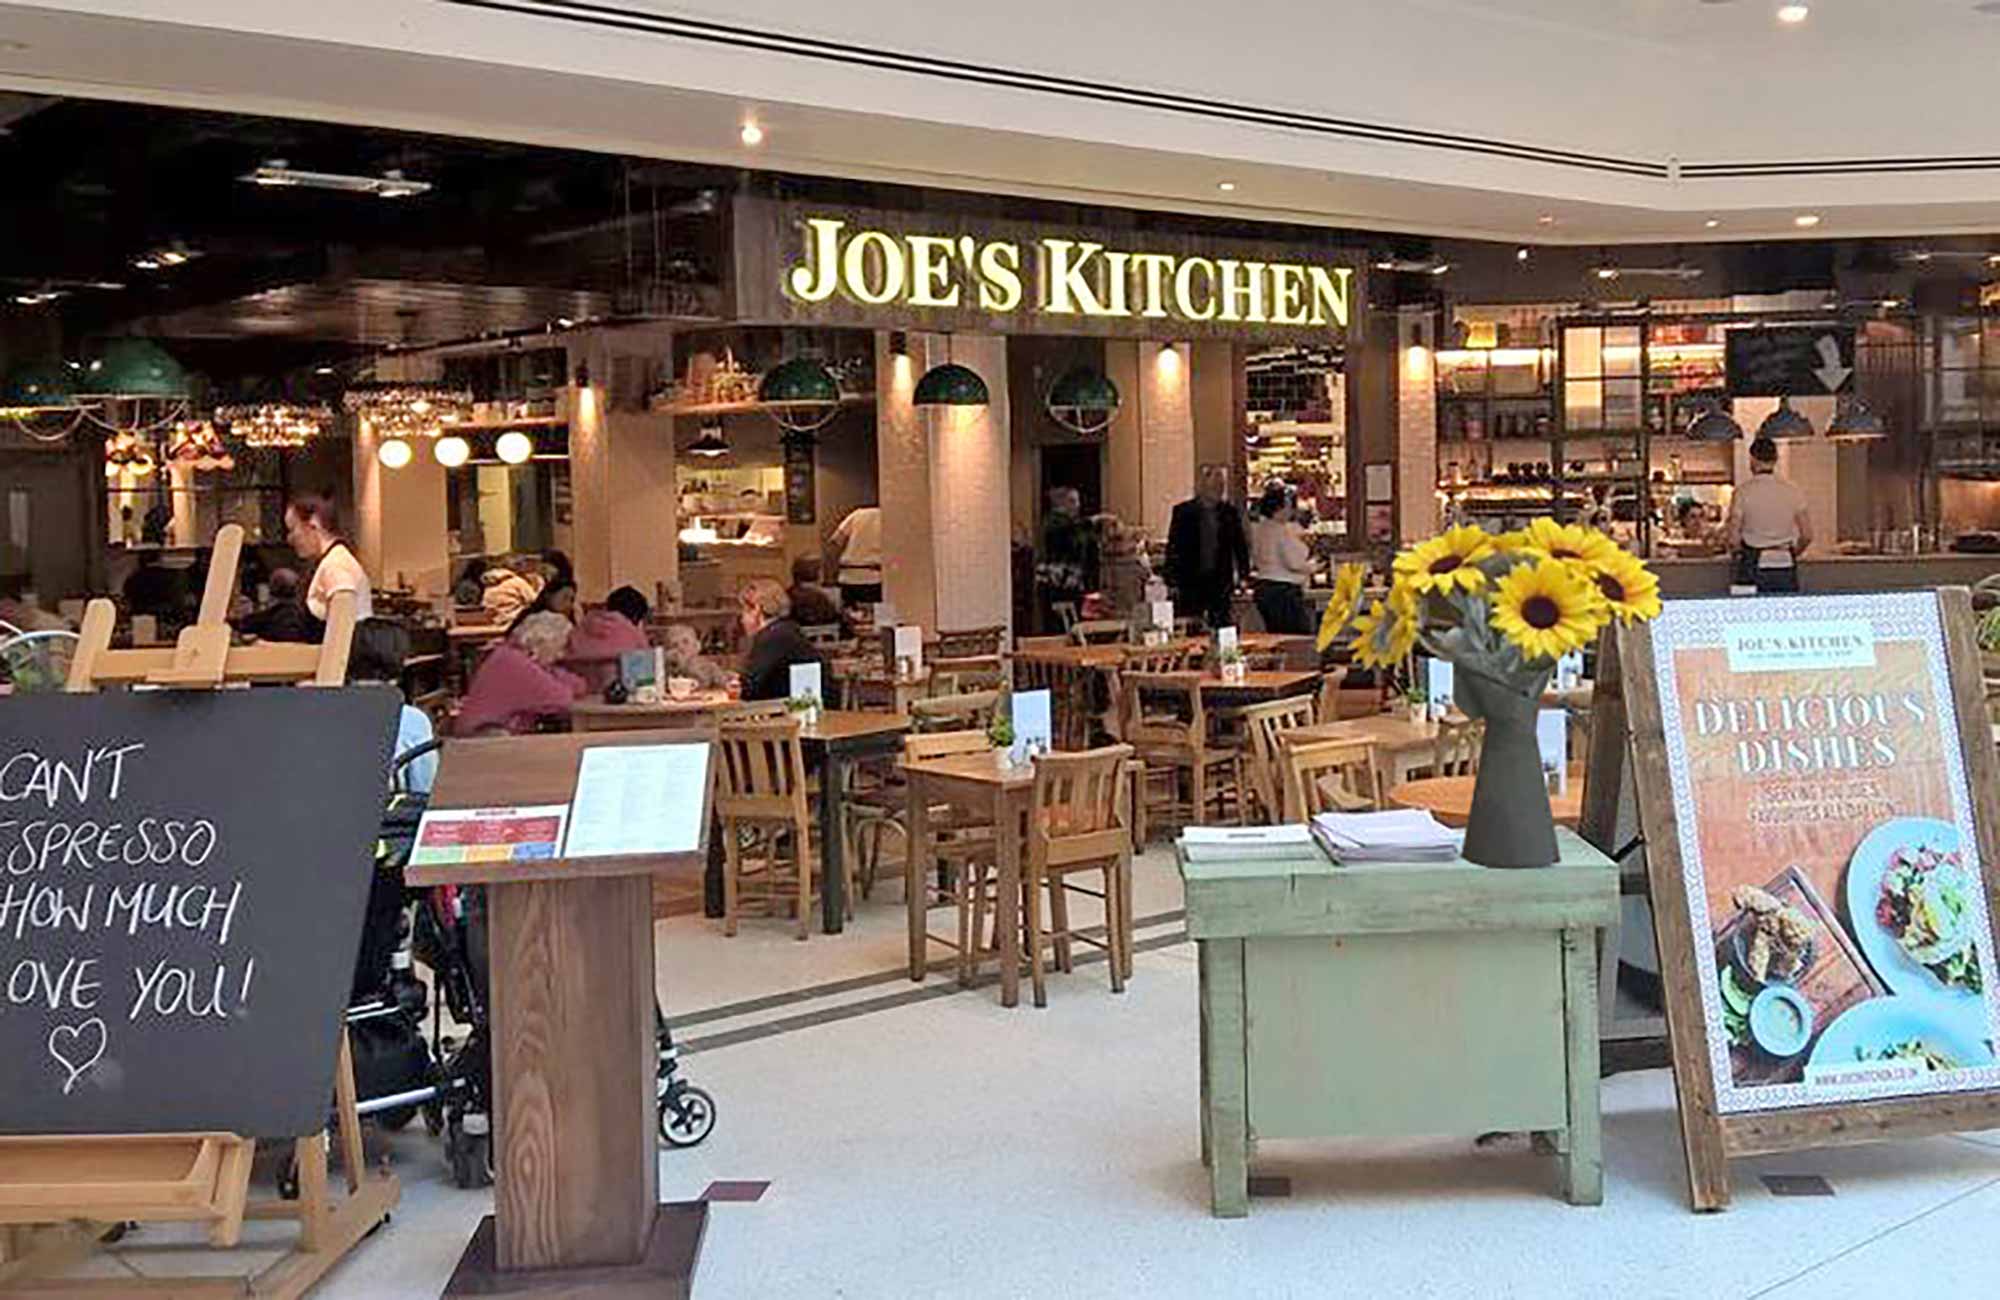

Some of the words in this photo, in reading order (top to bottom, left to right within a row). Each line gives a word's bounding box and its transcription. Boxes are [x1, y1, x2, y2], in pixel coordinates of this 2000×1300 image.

[790, 217, 1023, 313] JOE'S
[1042, 237, 1353, 327] KITCHEN
[1695, 691, 1927, 736] DELICIOUS
[0, 742, 145, 808] CAN'T
[1737, 731, 1898, 774] DISHES
[0, 818, 217, 875] SPRESSO
[0, 881, 95, 940] HOW
[104, 881, 242, 945] MUCH
[129, 956, 255, 1020] YOU!
